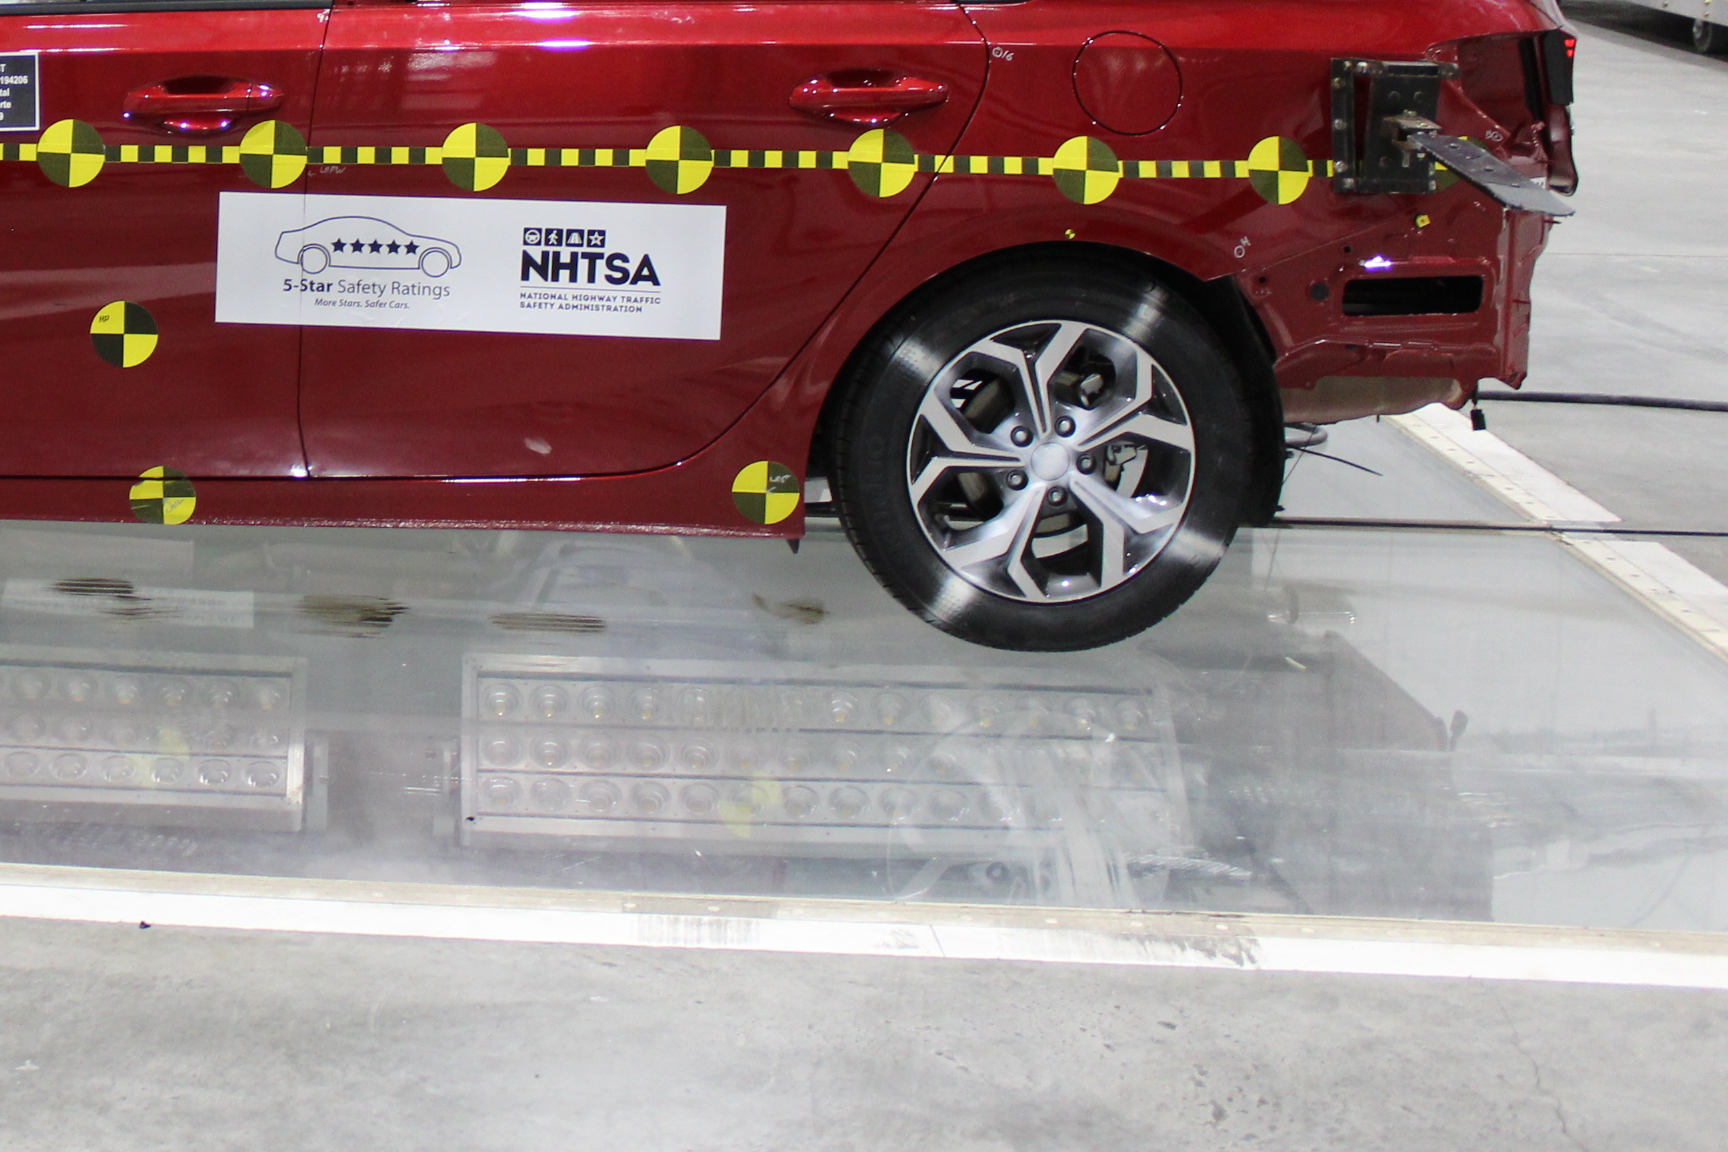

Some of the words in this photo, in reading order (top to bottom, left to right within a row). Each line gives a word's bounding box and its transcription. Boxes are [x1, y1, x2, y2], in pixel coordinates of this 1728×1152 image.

[520, 249, 661, 287] NHTSA
[282, 278, 333, 293] 5-Star
[337, 279, 387, 298] Safety
[391, 280, 451, 300] Ratings
[314, 298, 337, 307] More
[339, 299, 363, 308] Stars.
[364, 299, 388, 308] Safer
[388, 300, 410, 309] Cars.
[520, 292, 568, 301] NATIONAL
[571, 293, 618, 303] HIGHWAY
[621, 295, 662, 305] TRAFFIC
[520, 301, 555, 310] SAFETY
[557, 303, 643, 313] ADMINISTRATION
